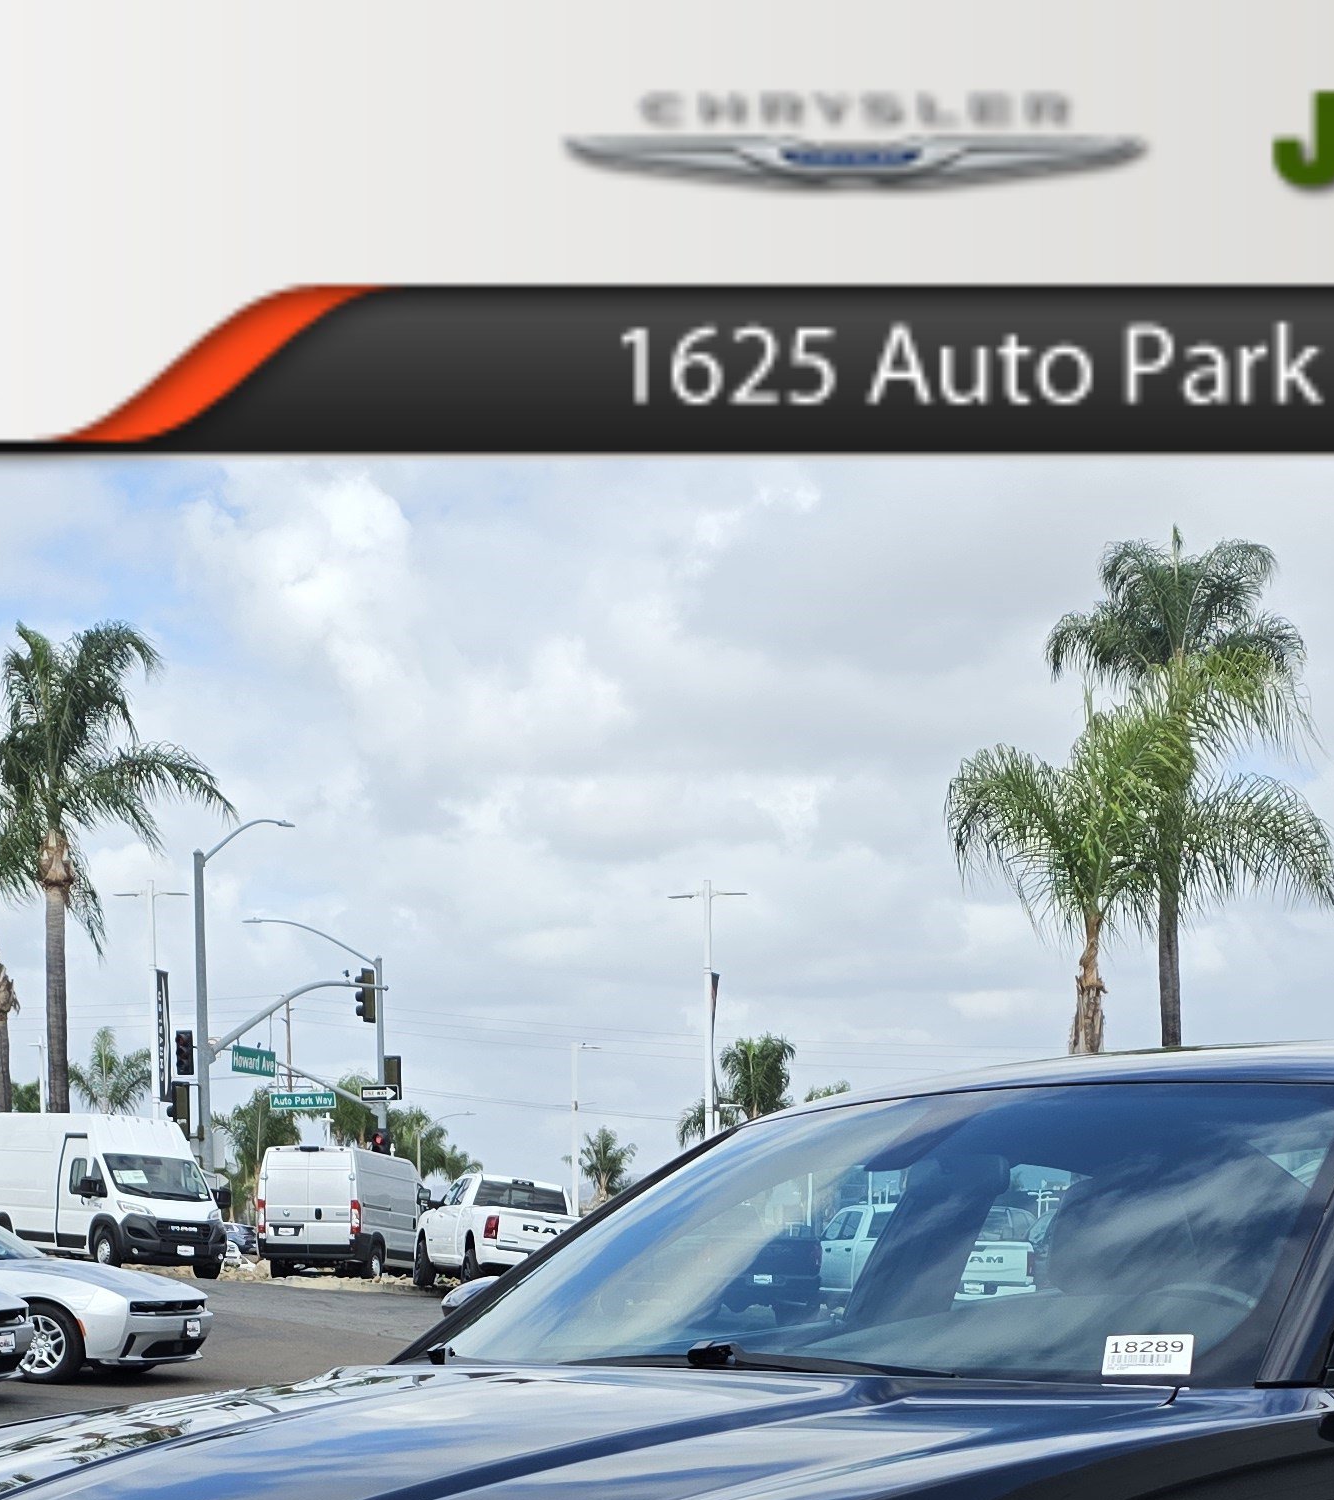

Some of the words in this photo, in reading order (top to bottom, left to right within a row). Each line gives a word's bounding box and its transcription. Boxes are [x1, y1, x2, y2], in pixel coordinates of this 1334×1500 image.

[233, 1051, 260, 1071] Howard
[261, 1056, 274, 1073] Ave
[273, 1096, 292, 1106] Auto
[294, 1095, 313, 1105] Park
[315, 1094, 333, 1107] Way
[1110, 1340, 1184, 1354] 18289
